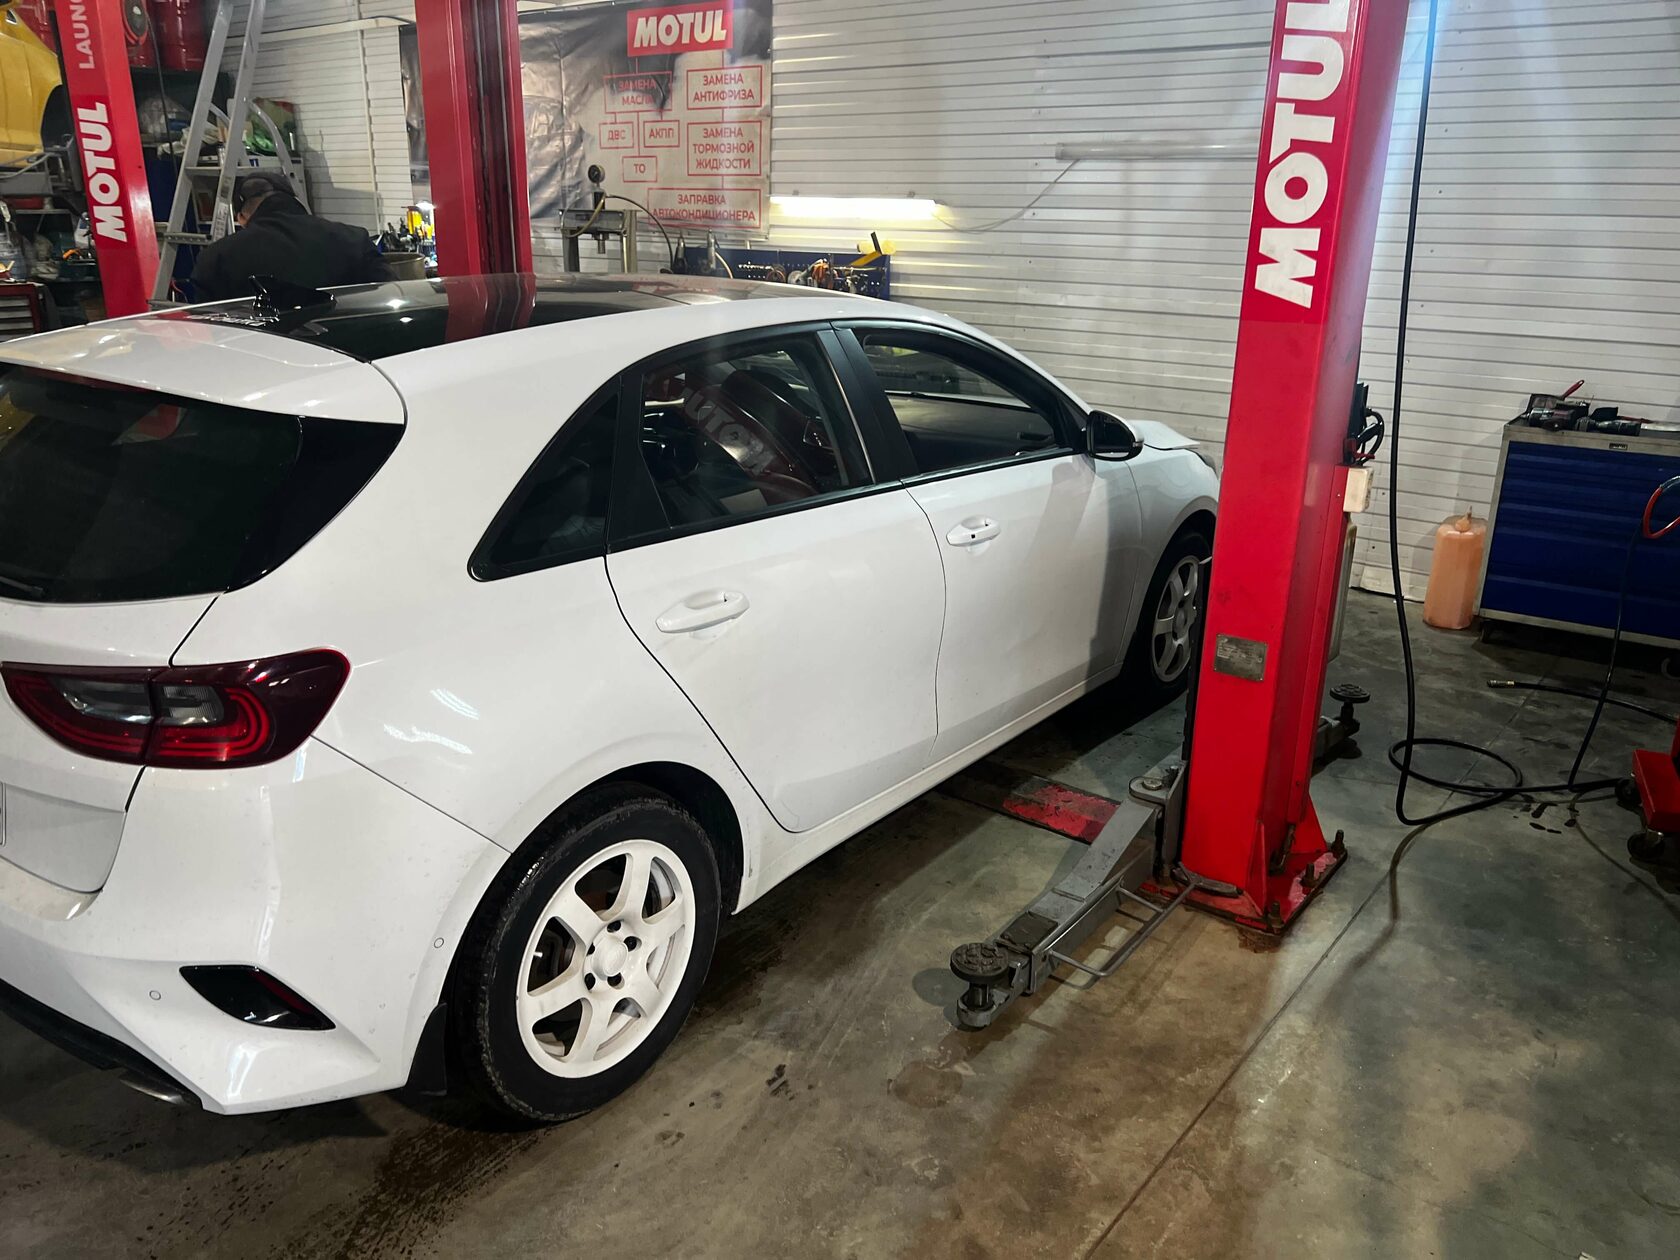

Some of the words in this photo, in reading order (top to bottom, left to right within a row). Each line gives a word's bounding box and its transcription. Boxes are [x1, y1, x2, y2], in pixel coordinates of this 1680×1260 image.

[69, 0, 95, 69] LAUN
[633, 9, 727, 48] MOTUL
[619, 78, 656, 90] ЗАМЕНА
[703, 73, 744, 86] ЗАМЕНА
[693, 88, 755, 102] АНТИФРИЗА
[608, 130, 626, 142] ДВС
[649, 127, 674, 139] АКПП
[703, 127, 743, 138] ЗАМЕНА
[693, 140, 755, 154] ТОРМОЗНОЙ
[1255, 0, 1350, 308] MOTUL
[633, 163, 646, 174] ТО
[696, 158, 751, 170] ЖИДКОСТИ
[77, 102, 127, 243] MOTUL
[677, 194, 727, 205] ЗАПРАВКА
[652, 208, 756, 221] АВТОКОНДИЦИОНЕРА
